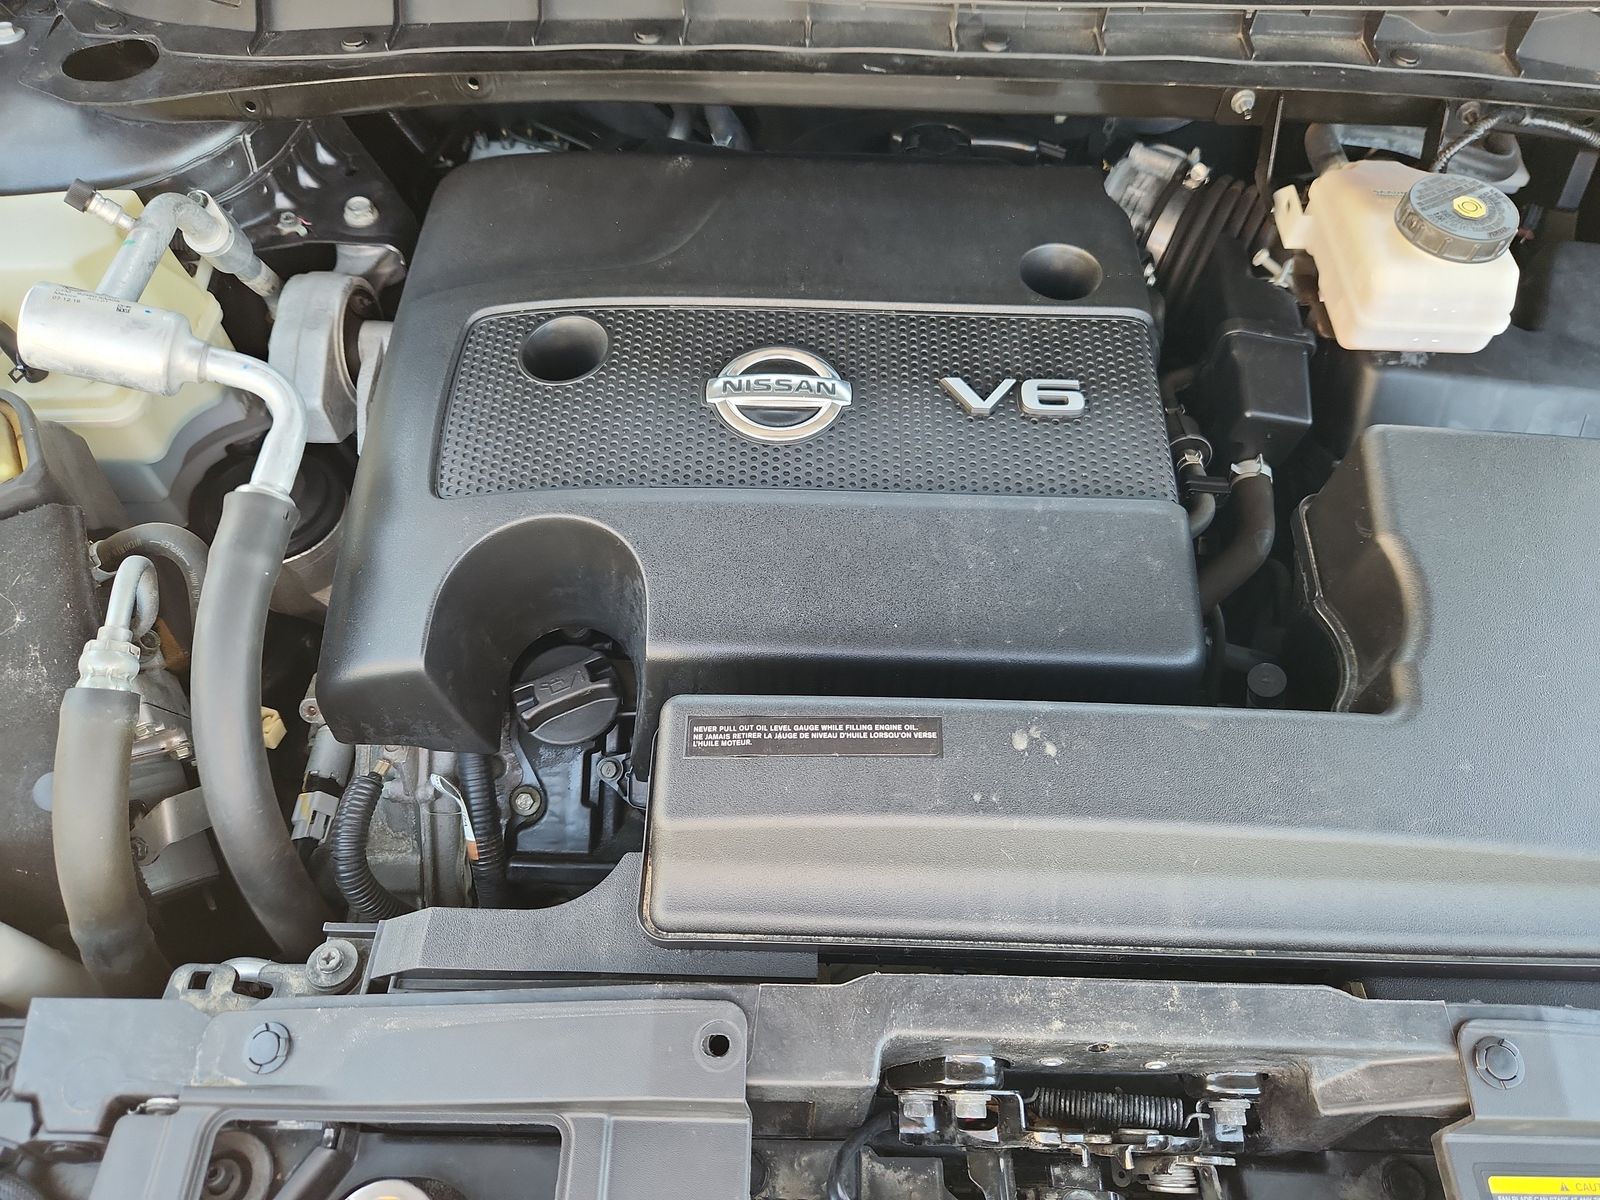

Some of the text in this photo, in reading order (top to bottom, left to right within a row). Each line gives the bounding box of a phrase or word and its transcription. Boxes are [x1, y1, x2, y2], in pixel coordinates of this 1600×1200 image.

[722, 378, 836, 396] NISSAN
[938, 377, 1085, 417] V6
[720, 739, 753, 747] MOTEUR.
